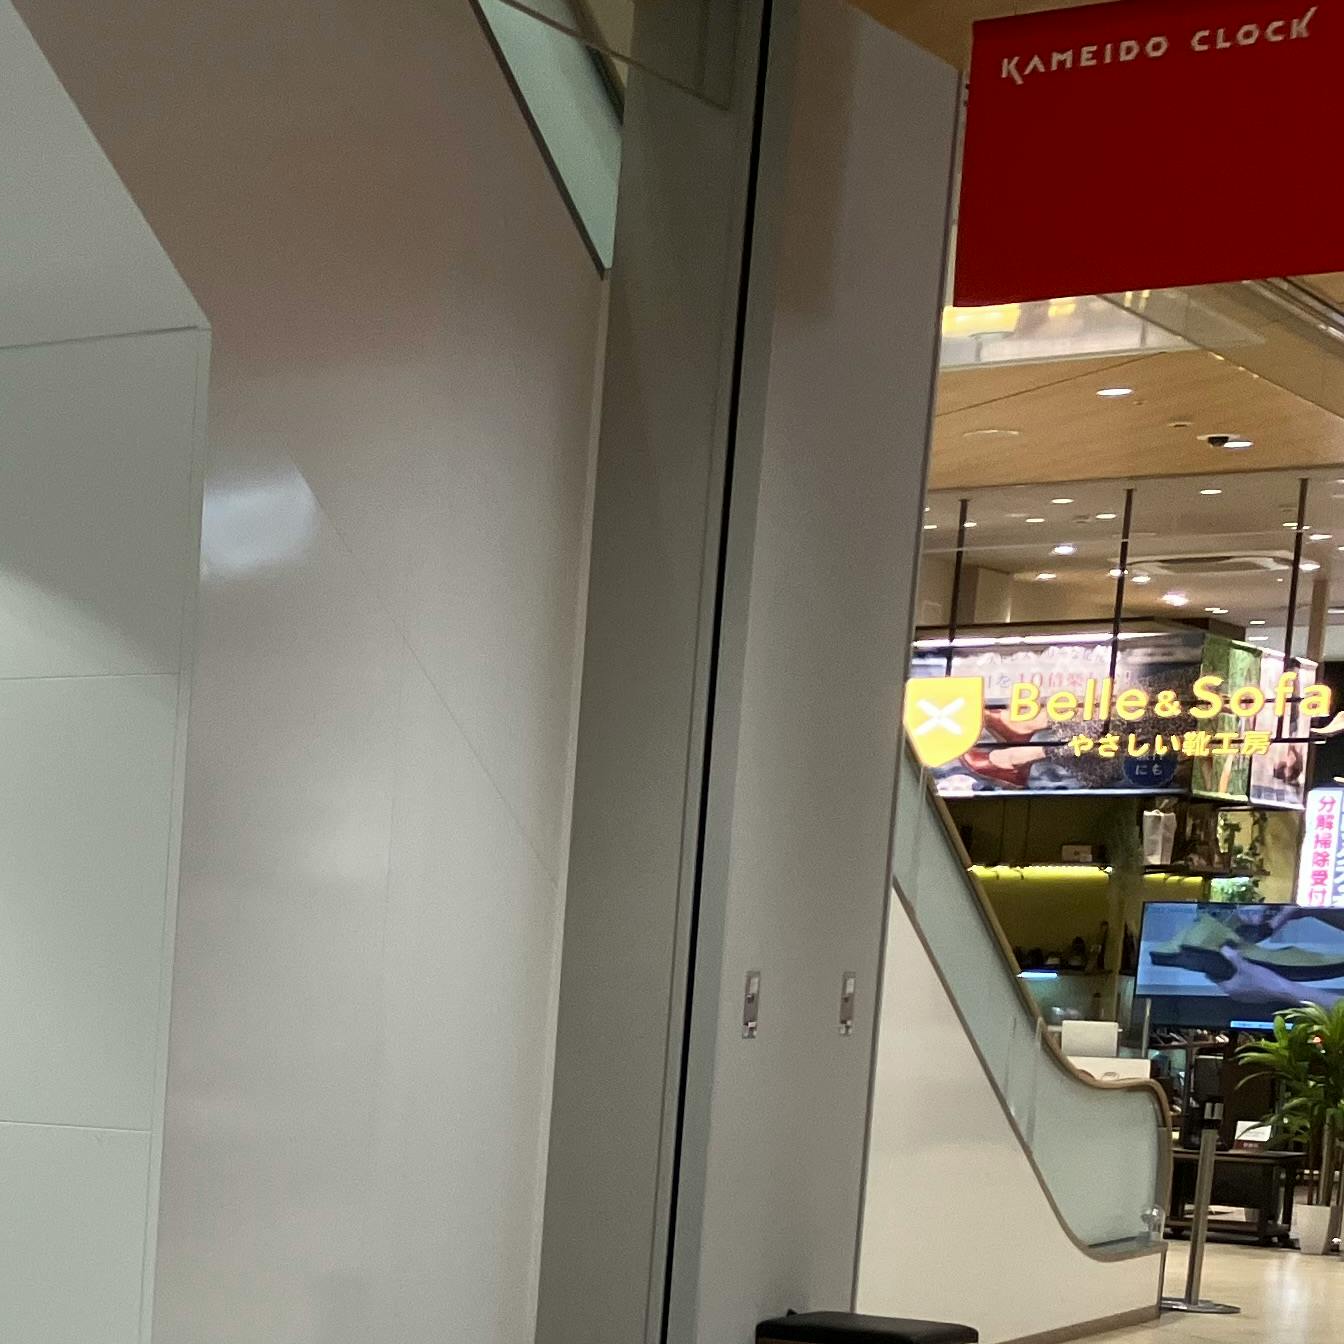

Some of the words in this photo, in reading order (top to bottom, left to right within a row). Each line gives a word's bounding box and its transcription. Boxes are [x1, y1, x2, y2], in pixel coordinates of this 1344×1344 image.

[1000, 36, 1168, 84] KAMEIDO
[1190, 6, 1318, 53] CLOCK
[1068, 730, 1272, 758] やさしい靴工房
[1308, 795, 1336, 908] 分解掃除受付
